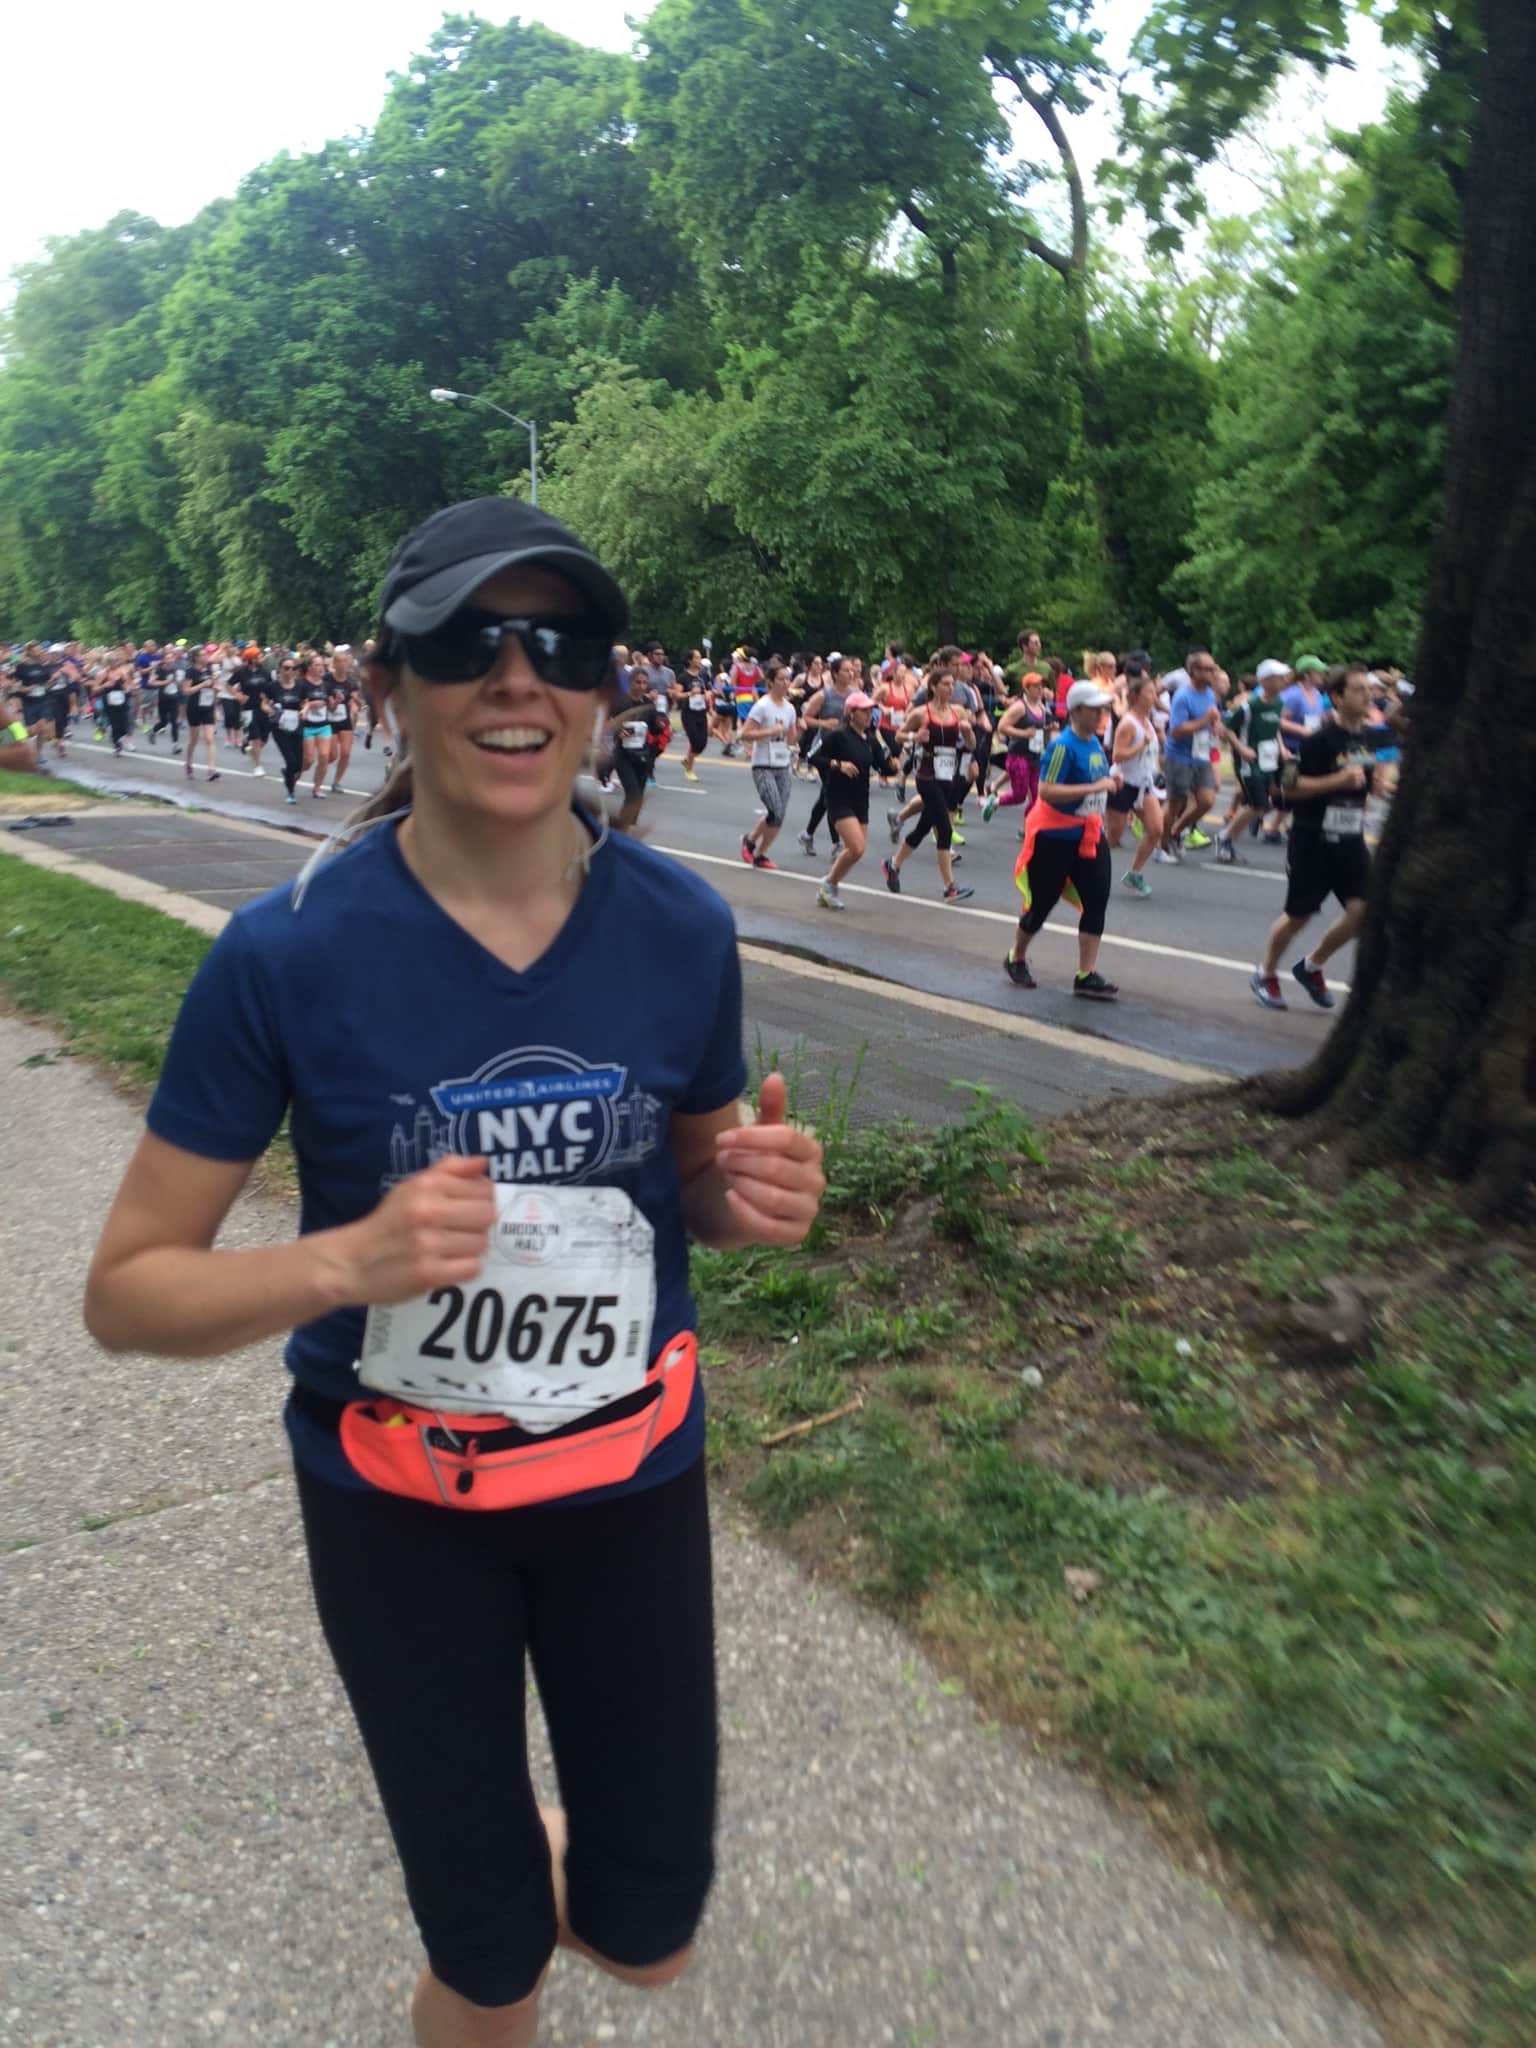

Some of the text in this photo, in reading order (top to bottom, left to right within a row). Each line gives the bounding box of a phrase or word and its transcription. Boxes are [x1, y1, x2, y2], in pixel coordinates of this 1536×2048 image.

[450, 1077, 612, 1106] UNITED AIRLINES
[477, 1100, 594, 1152] NYC
[489, 1146, 585, 1180] HALF
[419, 1285, 618, 1367] 20675
